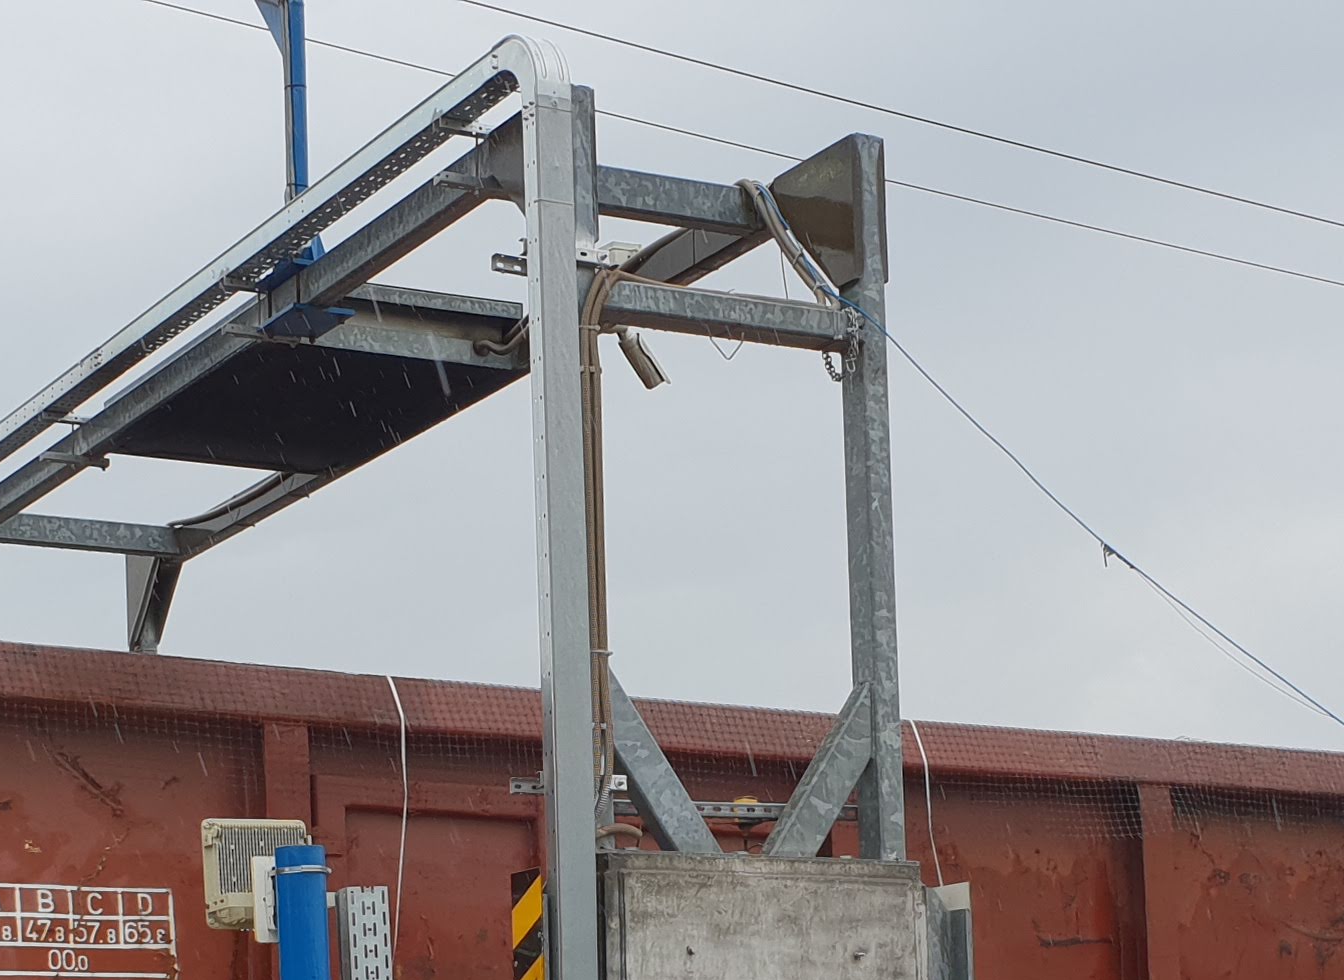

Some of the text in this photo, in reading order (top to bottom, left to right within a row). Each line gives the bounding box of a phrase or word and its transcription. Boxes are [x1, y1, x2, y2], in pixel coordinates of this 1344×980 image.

[36, 889, 55, 914] B
[87, 892, 103, 915] C
[137, 893, 153, 916] D
